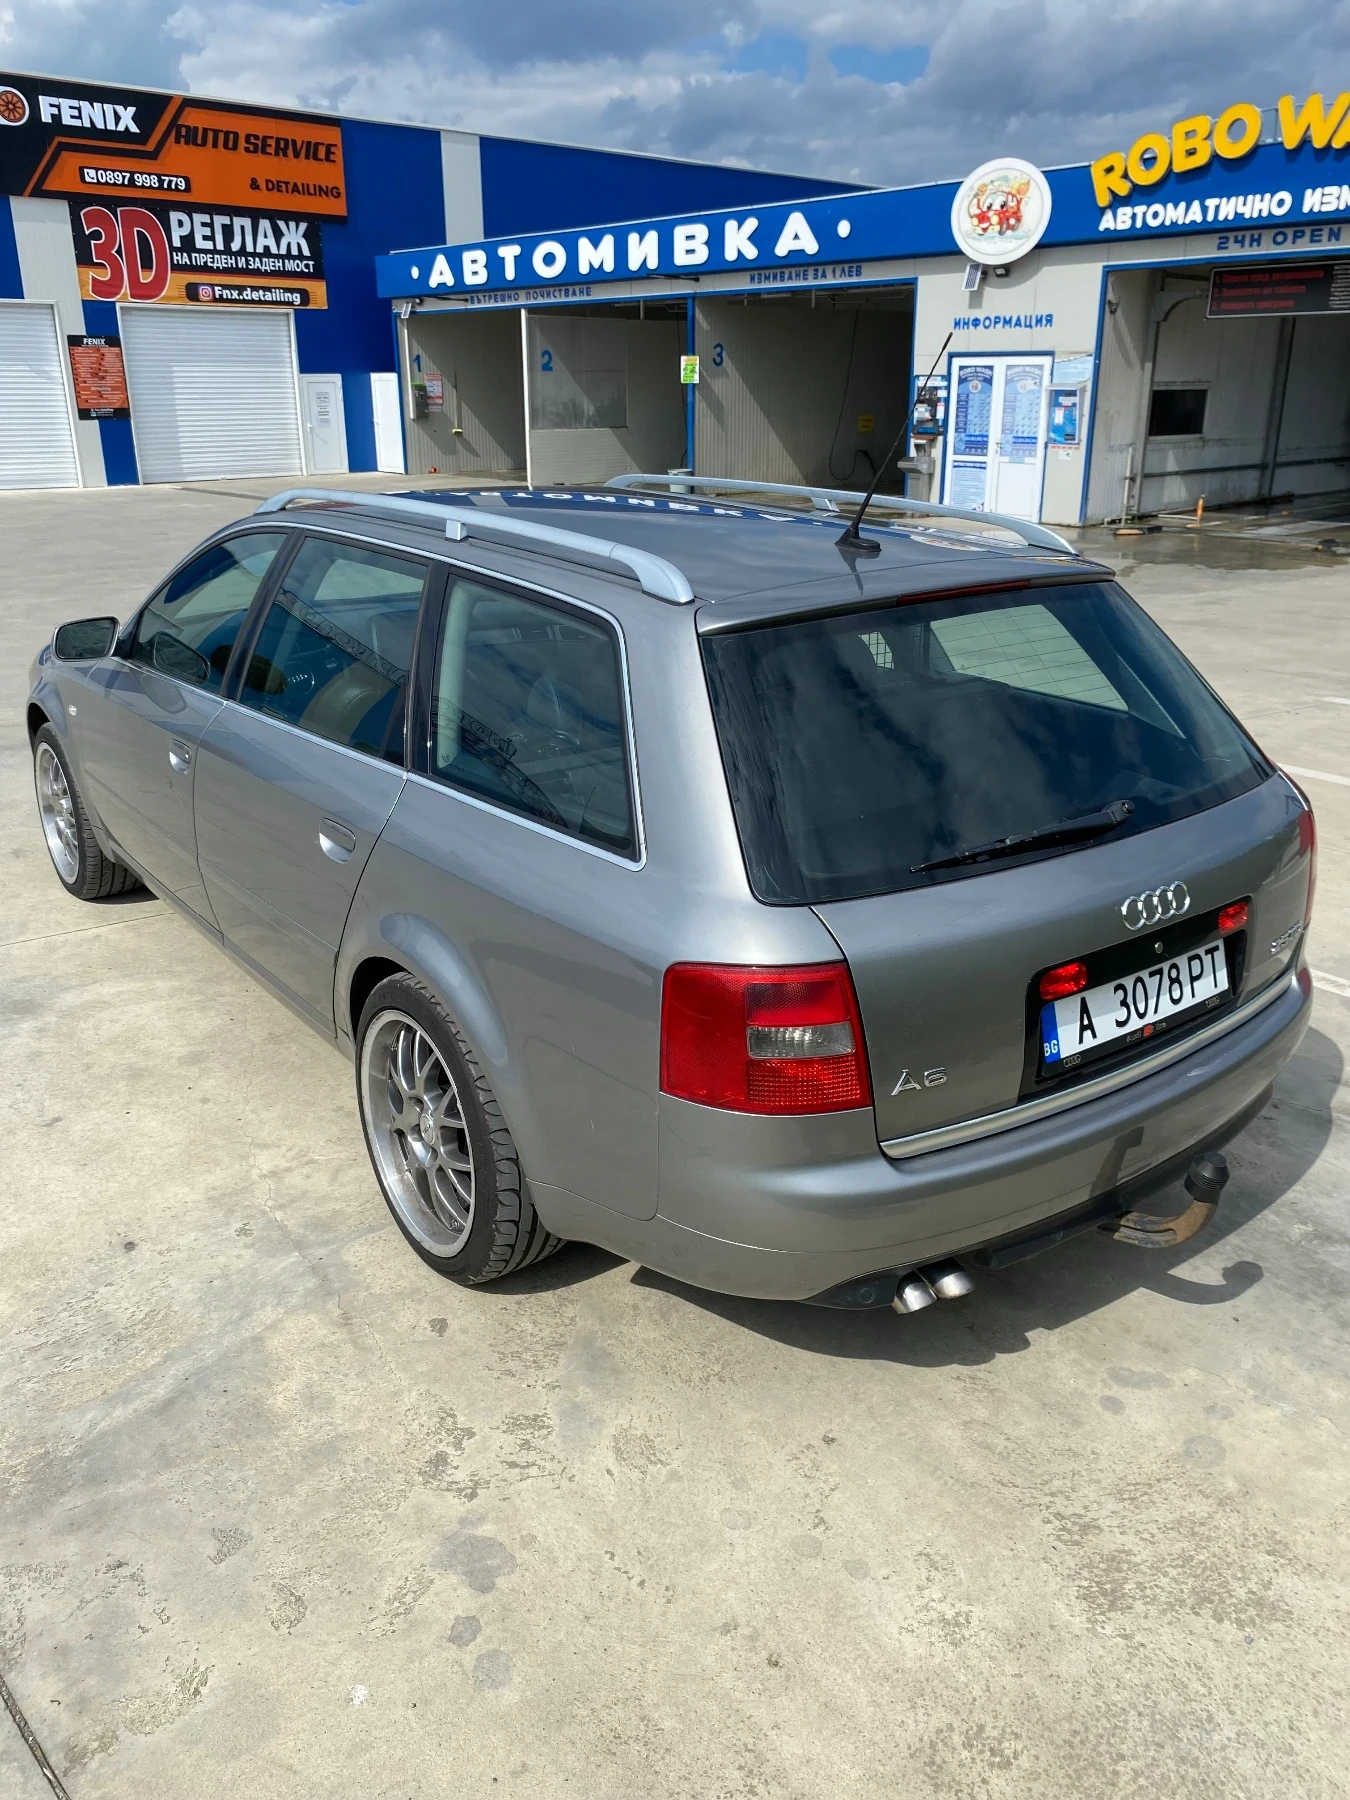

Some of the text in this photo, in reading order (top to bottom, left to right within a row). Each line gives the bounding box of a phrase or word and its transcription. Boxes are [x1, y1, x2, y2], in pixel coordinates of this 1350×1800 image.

[38, 95, 140, 133] FENIX
[174, 123, 338, 163] AUTO SERVICE
[1091, 102, 1262, 208] ROBO
[97, 169, 186, 190] 0897 998 779
[249, 178, 341, 199] & DETAILING
[1098, 190, 1293, 232] АВТОМАТИЧНО
[169, 211, 311, 257] РЕГЛАЖ
[1216, 226, 1342, 251] 24H OPEN
[80, 206, 171, 302] 3D
[428, 211, 820, 288] АВТОМИВКА
[172, 252, 315, 273] НА ПРЕДЕН И ЗАДЕН МОСТ
[749, 268, 809, 284] ИЗМИВАНЕ
[812, 267, 828, 280] ЗА
[839, 264, 863, 279] ЛЕВ
[214, 286, 301, 305] Fnx.detailing
[469, 286, 593, 305] ВЪТРЕШНО ПОЧИСТВАНЕ
[953, 313, 1054, 331] ИНФОРМАЦИЯ
[83, 338, 106, 346] FENIX
[412, 354, 421, 372] 1
[540, 349, 553, 371] 2
[712, 342, 725, 367] 3
[1077, 945, 1220, 1045] A 3078 PT
[1043, 1039, 1059, 1057] BG
[890, 1067, 949, 1097] A6
